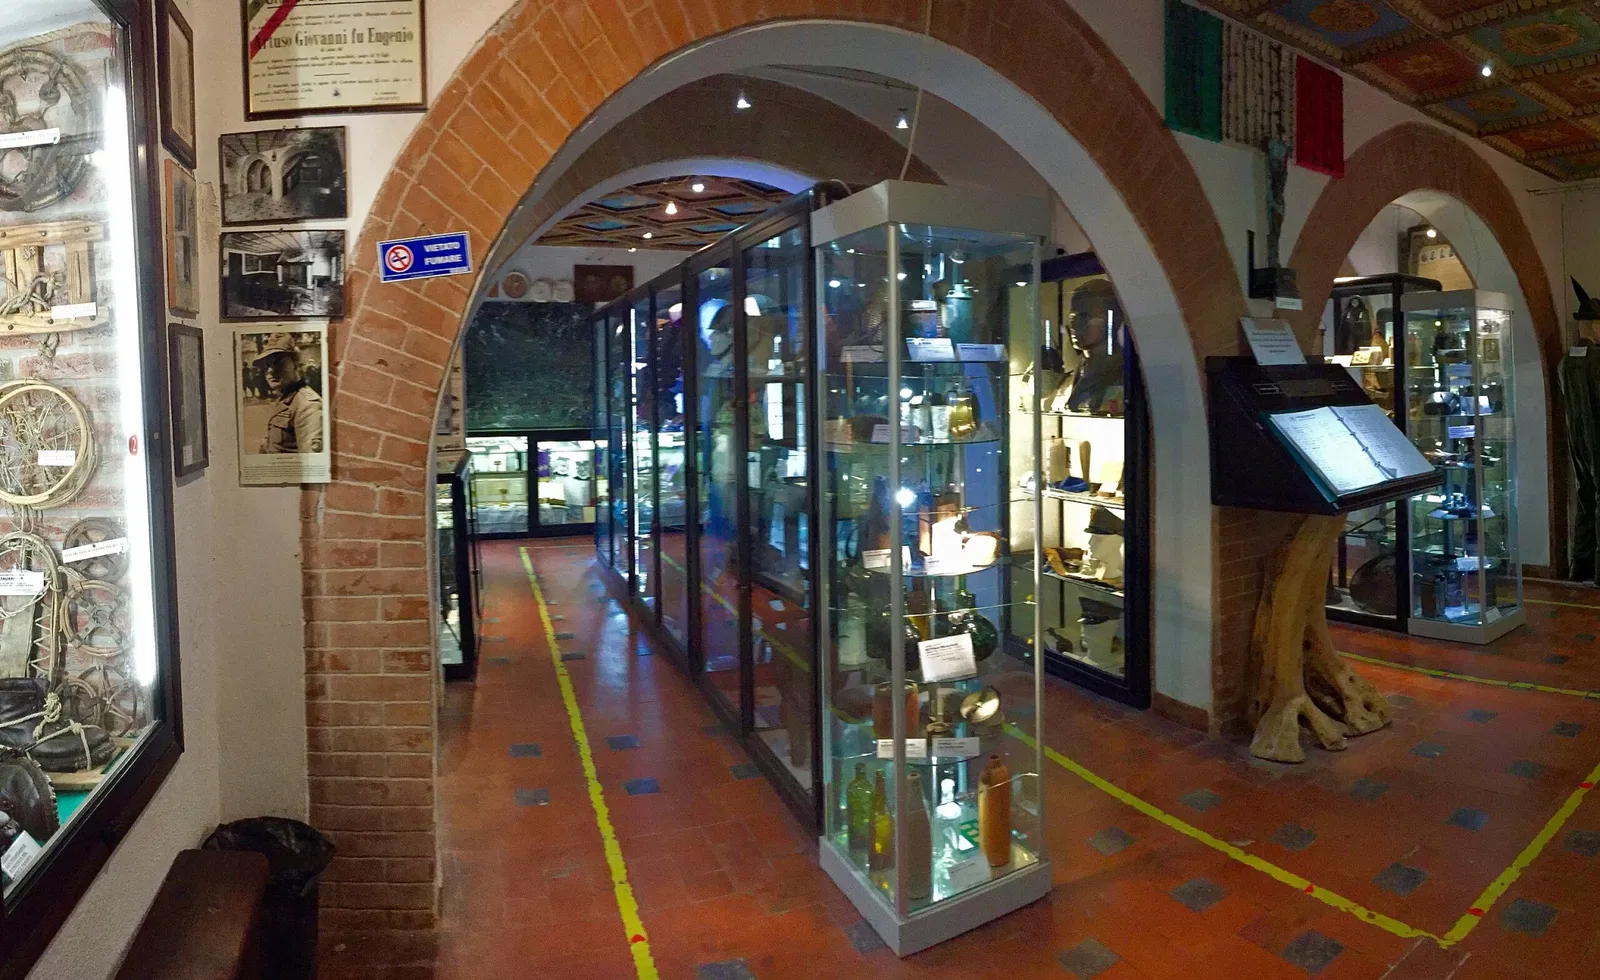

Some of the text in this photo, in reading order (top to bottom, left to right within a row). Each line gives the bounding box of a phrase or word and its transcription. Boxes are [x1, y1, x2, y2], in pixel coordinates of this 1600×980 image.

[295, 29, 347, 47] Giovanni
[351, 28, 364, 44] fu
[368, 27, 414, 46] Eugenio
[423, 241, 461, 252] VIETATO
[424, 254, 463, 266] FUMARE
